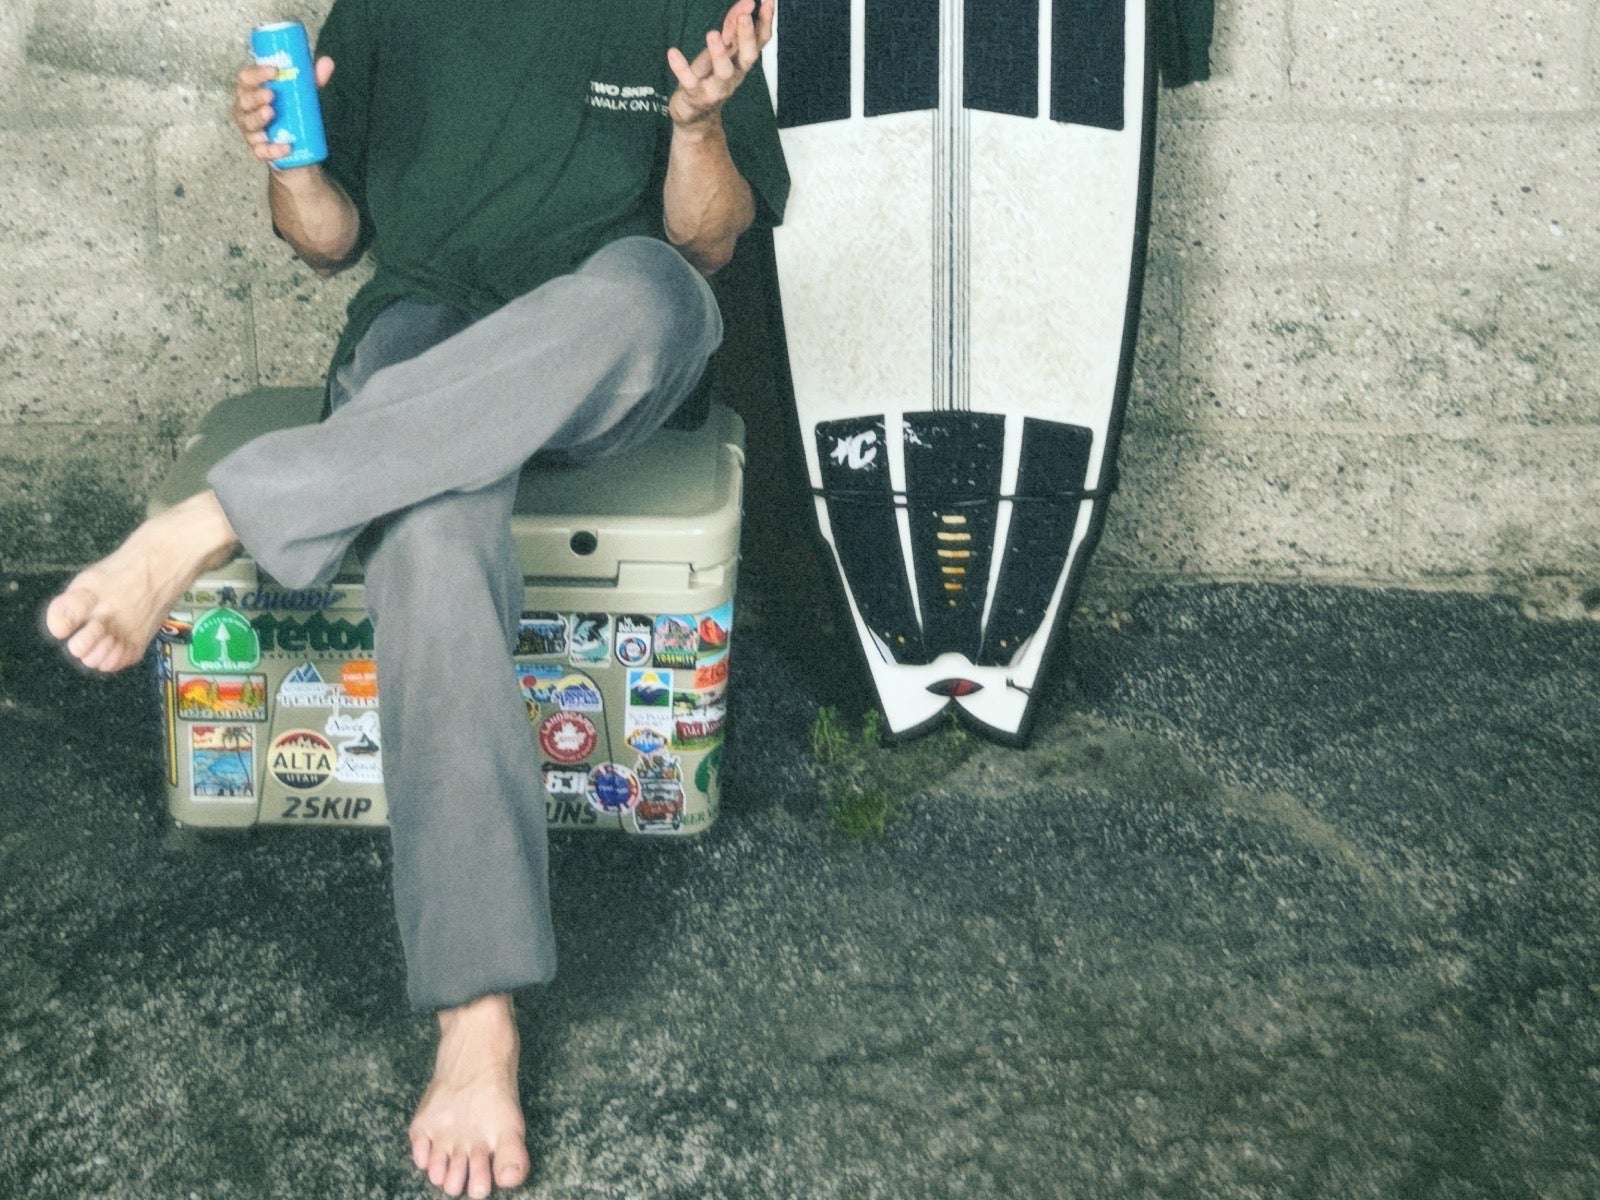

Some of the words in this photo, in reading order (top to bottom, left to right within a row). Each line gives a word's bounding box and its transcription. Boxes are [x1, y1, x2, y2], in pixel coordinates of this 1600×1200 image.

[629, 99, 650, 112] ON
[274, 753, 331, 771] ALTA
[282, 797, 372, 819] 2SKIP
